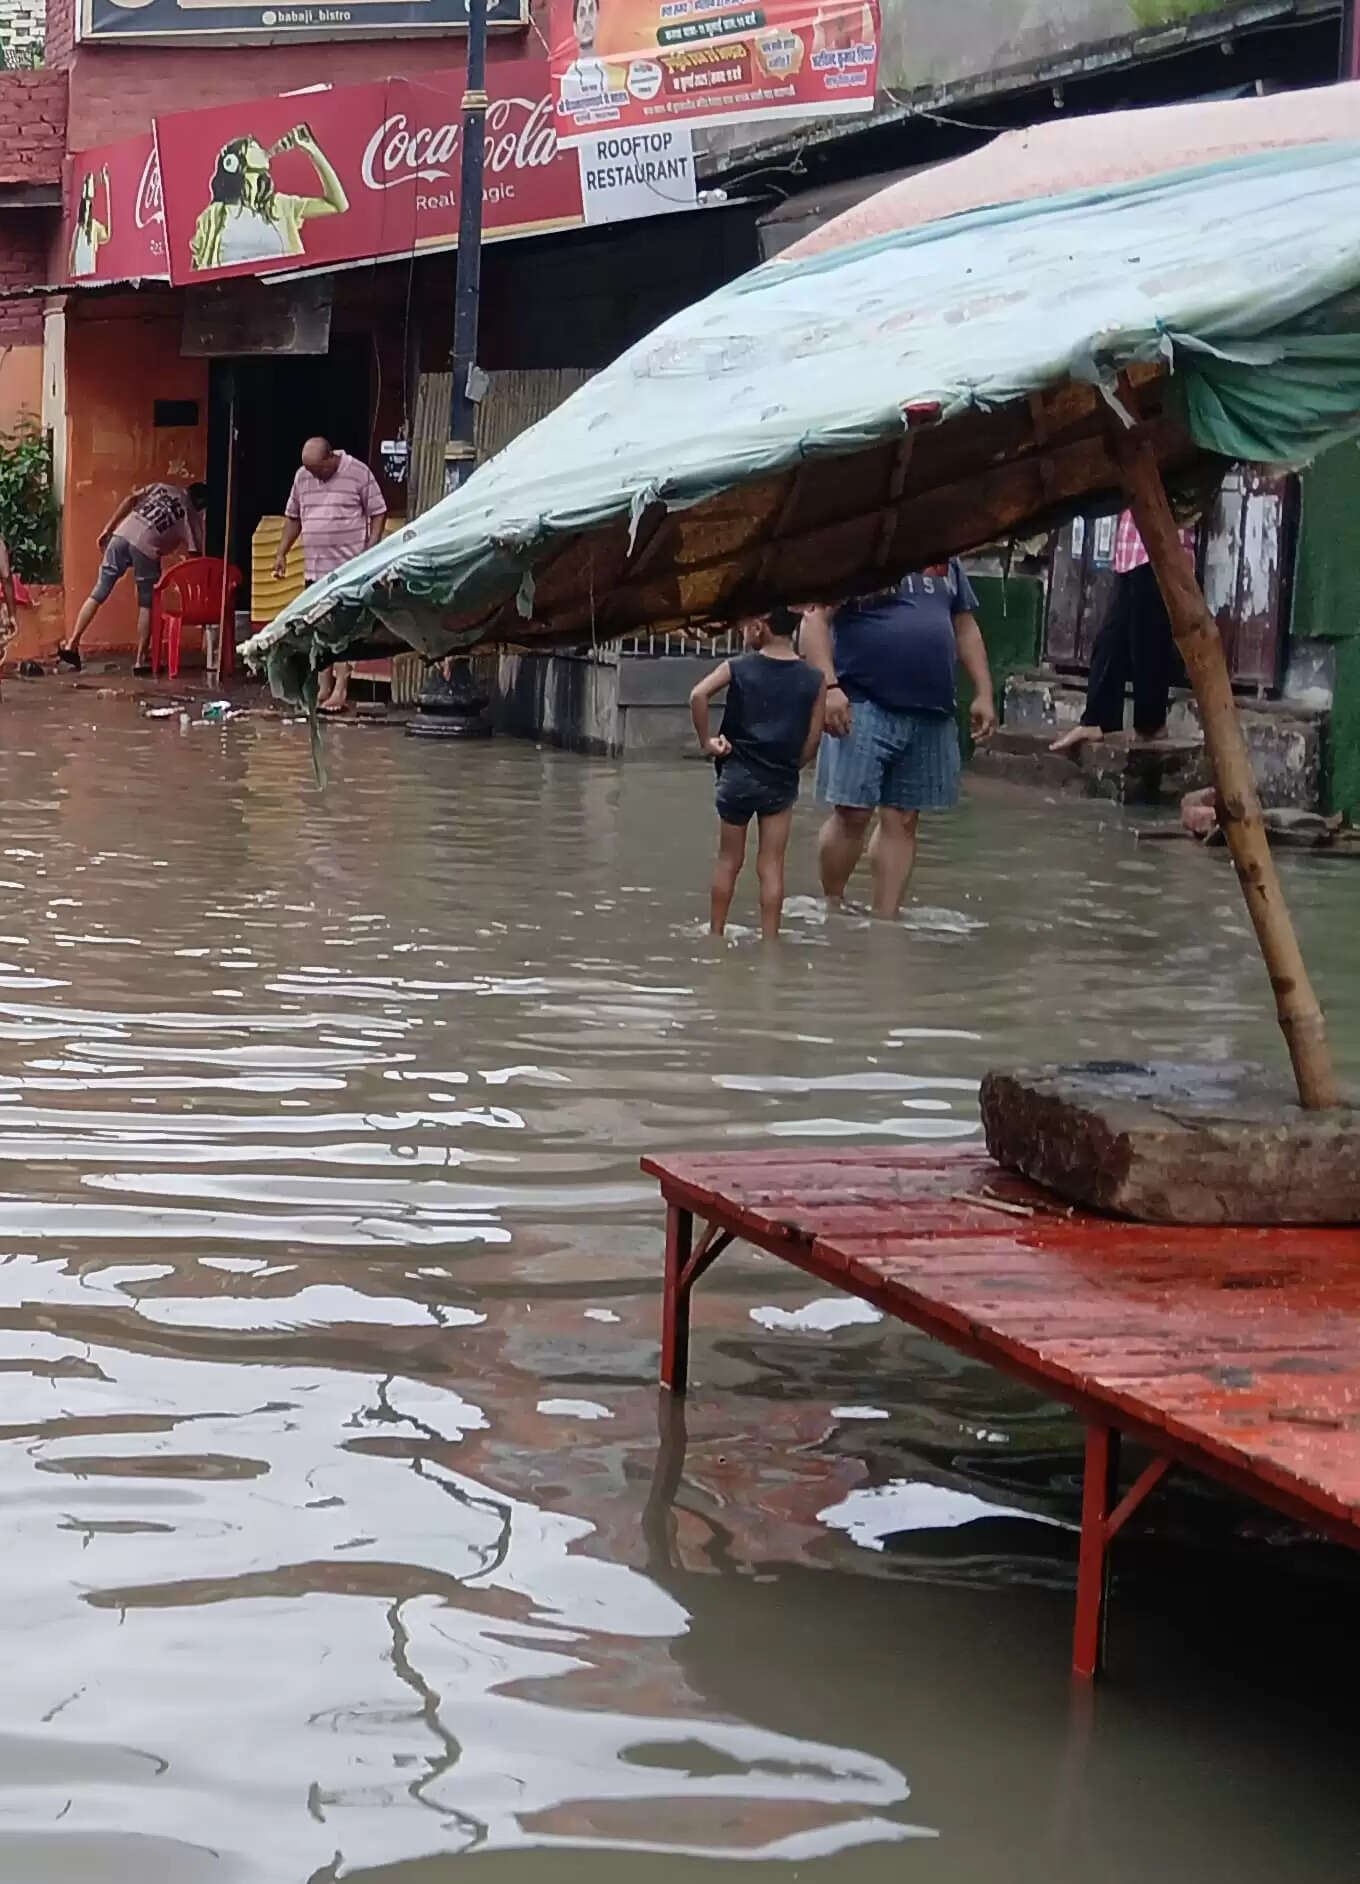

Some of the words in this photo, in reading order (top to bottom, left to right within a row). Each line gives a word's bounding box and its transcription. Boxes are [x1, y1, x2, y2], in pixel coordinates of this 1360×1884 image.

[596, 132, 673, 160] ROOFTOP
[586, 157, 688, 191] RESTAURANT
[416, 191, 455, 210] Real
